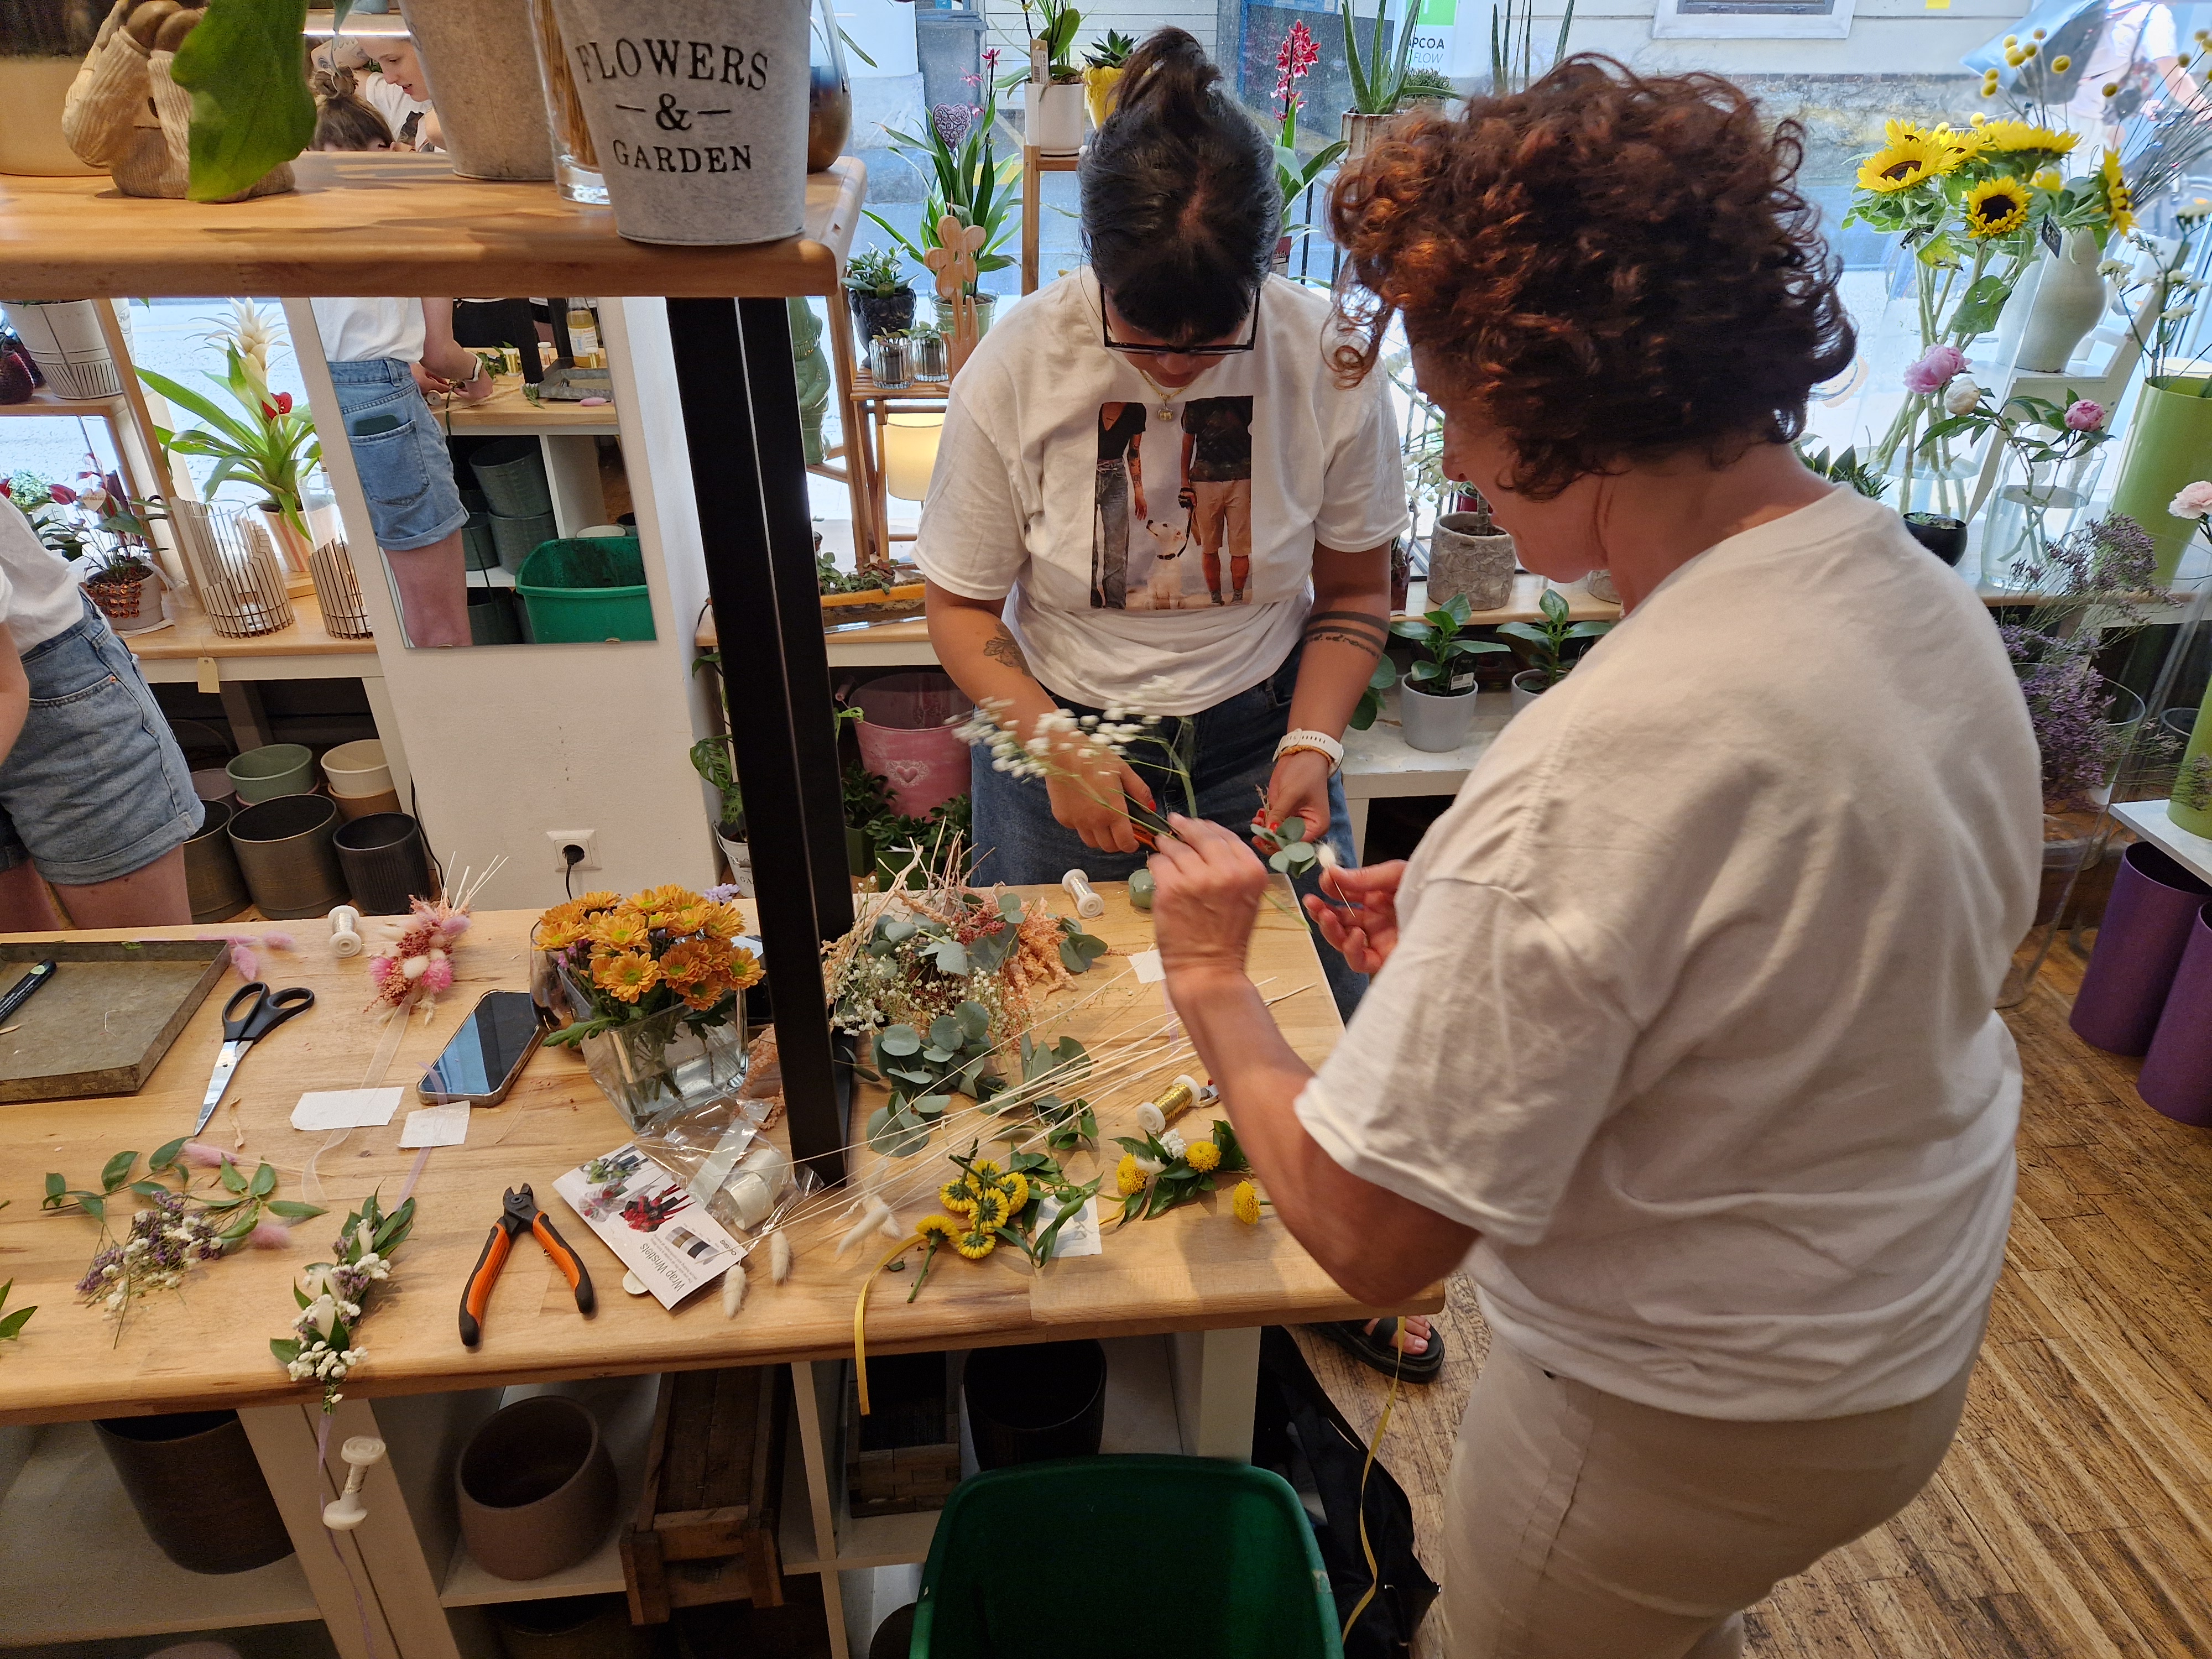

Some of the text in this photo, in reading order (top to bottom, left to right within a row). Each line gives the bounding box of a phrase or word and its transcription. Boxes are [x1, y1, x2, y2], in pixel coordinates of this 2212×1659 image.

[575, 38, 768, 91] FLOWERS
[1413, 52, 1443, 64] FLOW
[613, 139, 751, 173] GARDEN
[640, 1243, 667, 1274] Wristlets
[665, 1270, 685, 1291] Wrap
